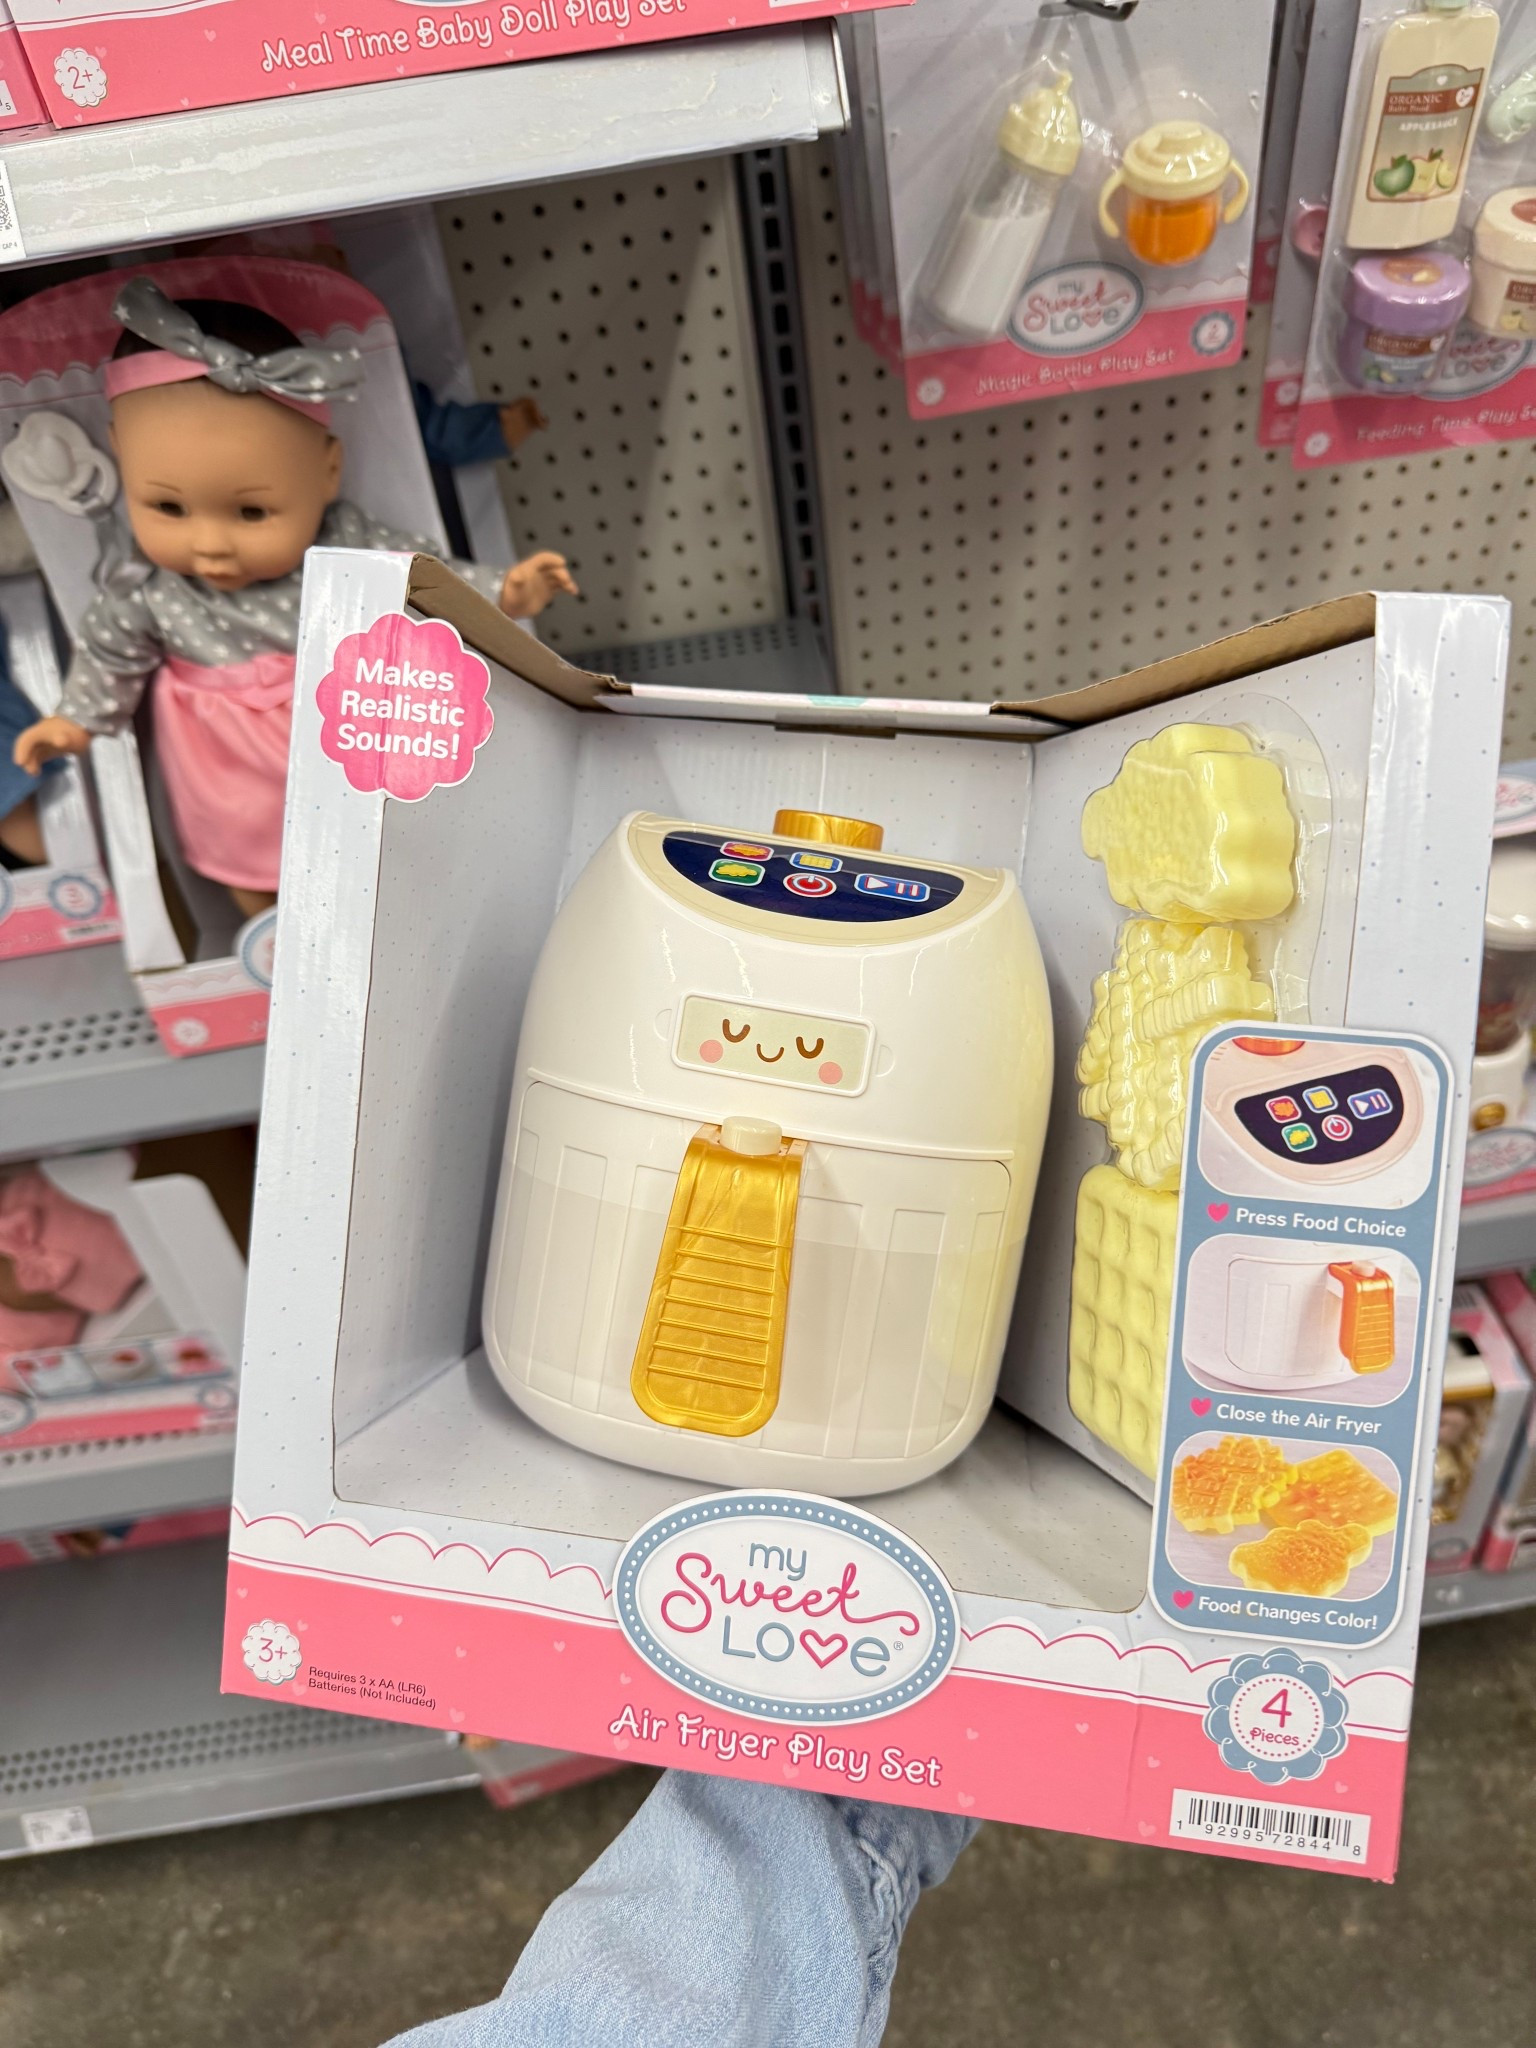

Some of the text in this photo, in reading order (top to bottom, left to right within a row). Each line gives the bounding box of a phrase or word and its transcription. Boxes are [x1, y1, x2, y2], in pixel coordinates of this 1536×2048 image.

[262, 31, 333, 72] Meal
[334, 26, 411, 60] Time
[416, 11, 494, 50] Baby
[500, 0, 559, 37] Doll
[565, 0, 631, 28] Play
[68, 66, 93, 90] 2+
[1389, 93, 1443, 105] ORGANIC
[1057, 279, 1084, 297] my
[1023, 279, 1132, 333] Sweet
[977, 349, 1176, 395] Magic Bottle Play Set
[1477, 409, 1517, 427] Play
[1520, 404, 1536, 420] Se
[355, 657, 454, 691] Makes
[341, 690, 465, 727] Realistic
[337, 723, 460, 760] Sounds!
[1236, 1208, 1406, 1237] Press Food Choice
[1216, 1404, 1382, 1436] Close the Air Fryer
[749, 1542, 807, 1581] my
[660, 1552, 920, 1637] Sweet
[1198, 1596, 1378, 1630] Food Changes Color!
[258, 1637, 288, 1663] 3+
[308, 1678, 437, 1710] Batteries (Not Included)
[309, 1666, 427, 1697] Requires 3 x AA (LR6)
[1261, 1688, 1292, 1729] 4
[609, 1704, 942, 1788] Air Fryer Play Set
[1250, 1727, 1300, 1746] Pieces
